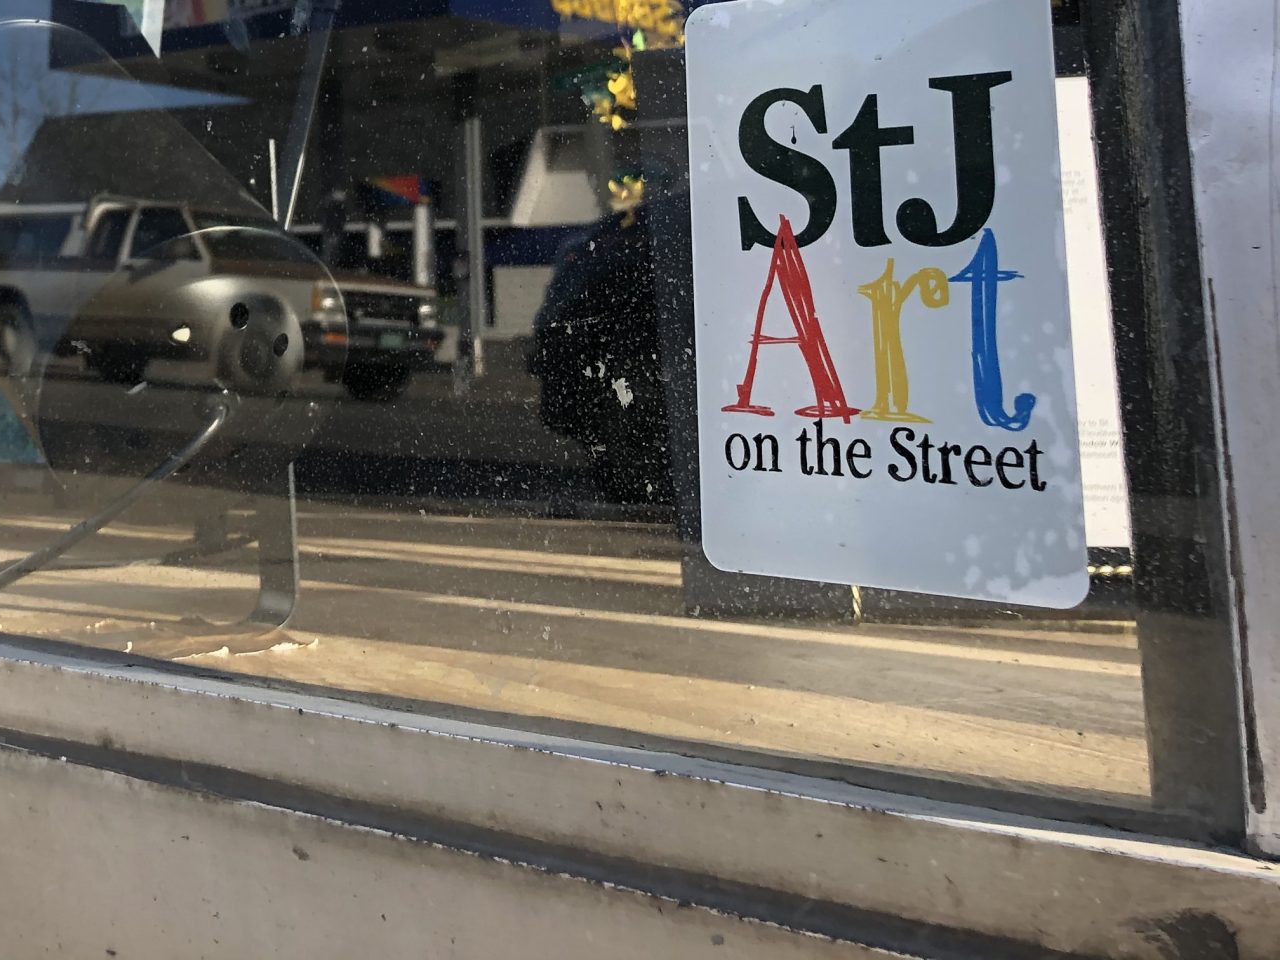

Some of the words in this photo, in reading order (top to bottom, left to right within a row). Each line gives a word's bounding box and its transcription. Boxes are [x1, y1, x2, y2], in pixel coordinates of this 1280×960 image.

[737, 70, 1013, 252] StJ
[721, 213, 1037, 431] Art
[724, 432, 783, 473] on
[796, 419, 873, 479] the
[887, 426, 1047, 492] Street
